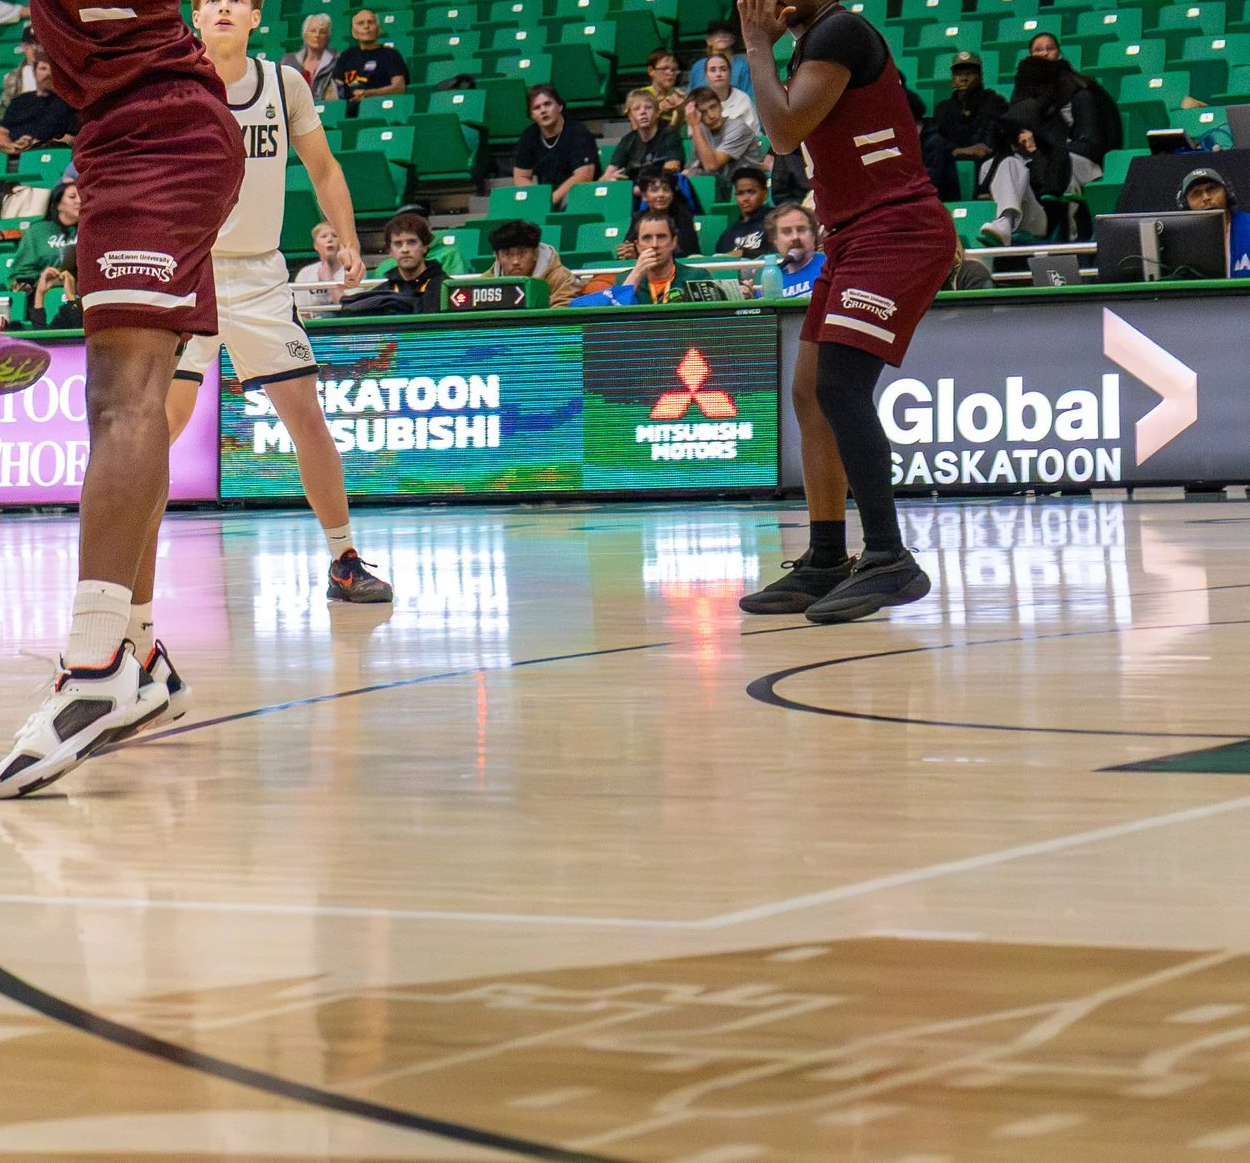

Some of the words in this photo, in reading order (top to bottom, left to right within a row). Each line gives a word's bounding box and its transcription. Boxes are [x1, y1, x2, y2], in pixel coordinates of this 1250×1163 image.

[104, 265, 171, 283] GRIFFINS
[472, 287, 503, 307] poss
[842, 298, 889, 321] GRIFFINS
[244, 374, 501, 416] SKATOON
[877, 373, 1121, 445] Global
[253, 415, 501, 454] MSUBISHI
[635, 421, 754, 443] MITSUBISHI
[651, 441, 738, 461] MOTORS
[890, 447, 1122, 486] SASKATOON
